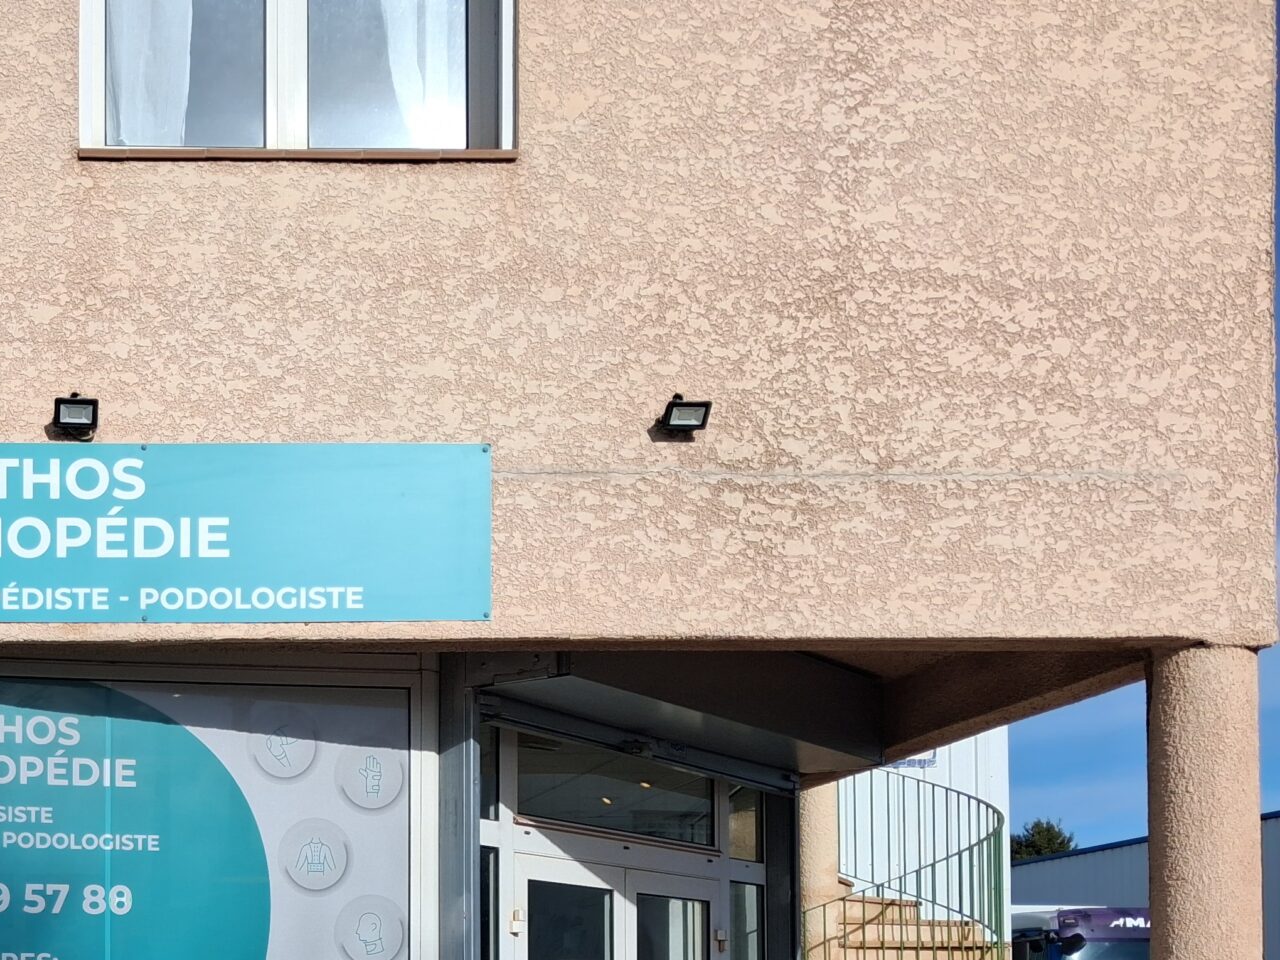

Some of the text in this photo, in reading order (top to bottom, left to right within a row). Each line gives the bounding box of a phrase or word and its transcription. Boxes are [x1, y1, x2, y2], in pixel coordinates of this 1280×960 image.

[139, 586, 365, 610] PODOLOGISTE
[2, 831, 160, 852] PODOLOGISTE
[22, 883, 70, 914] 57
